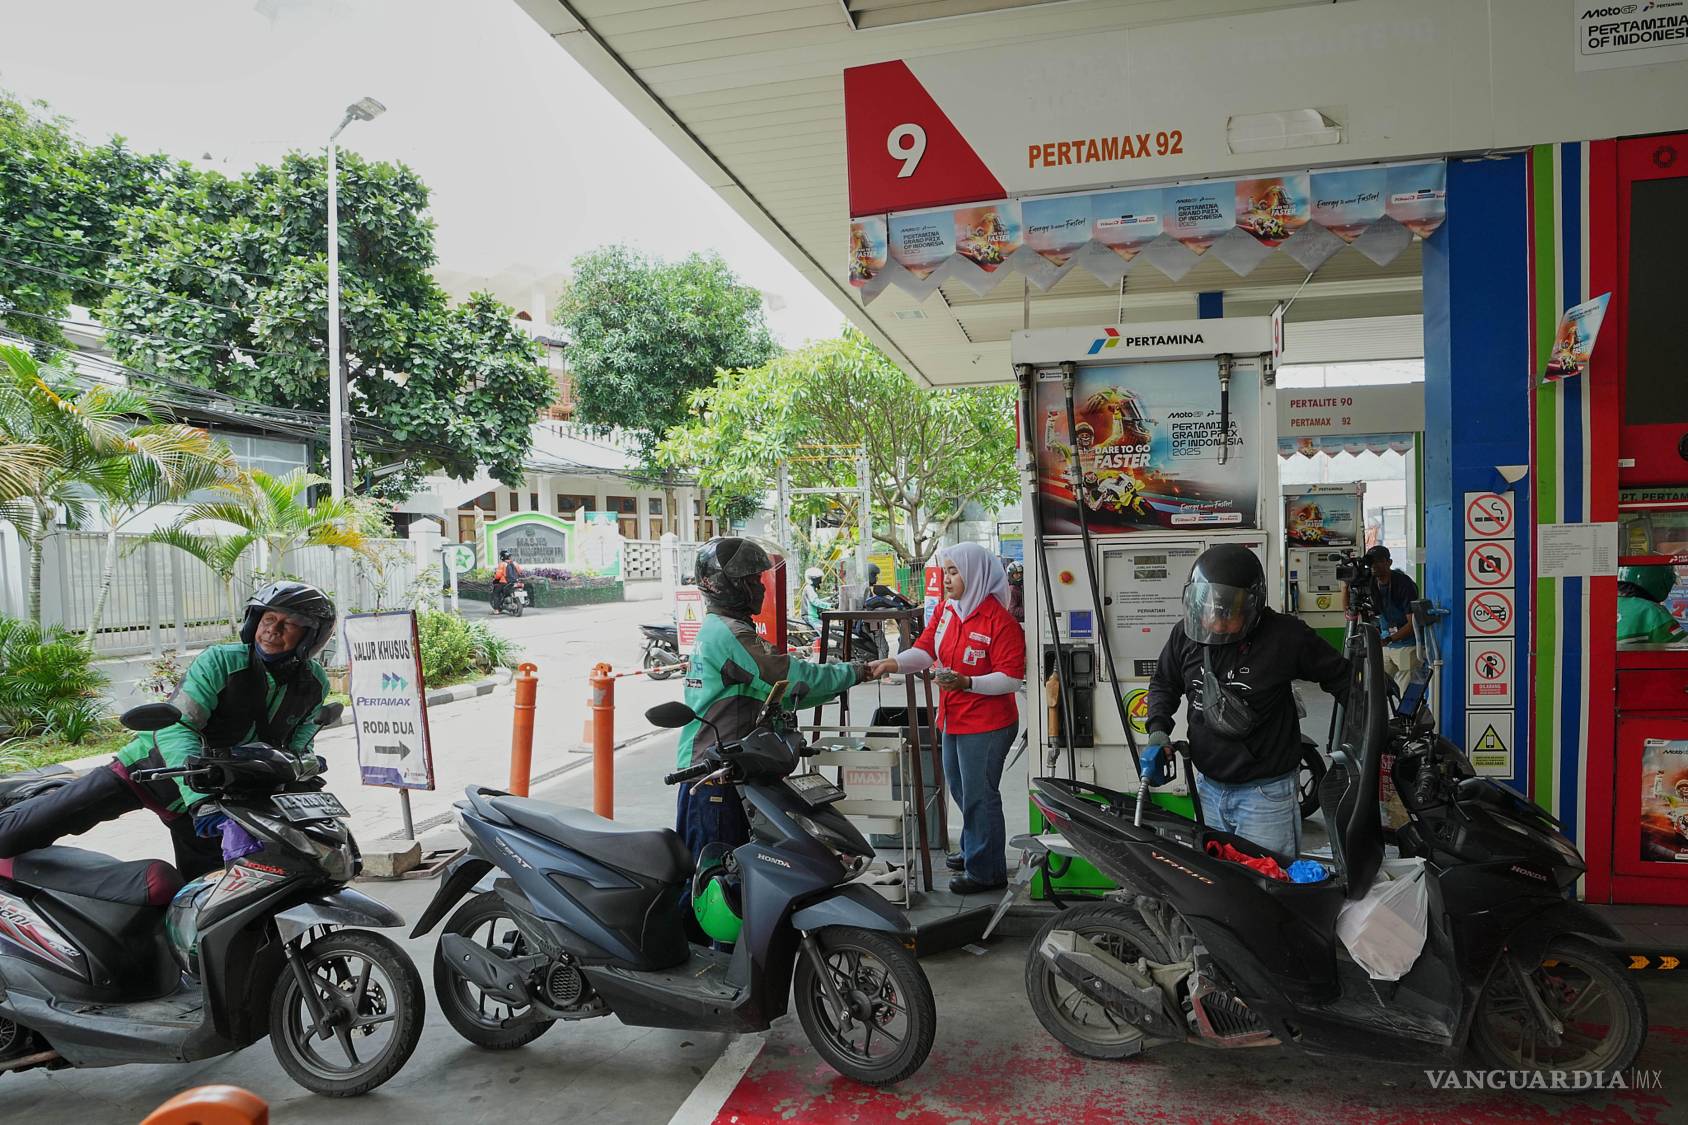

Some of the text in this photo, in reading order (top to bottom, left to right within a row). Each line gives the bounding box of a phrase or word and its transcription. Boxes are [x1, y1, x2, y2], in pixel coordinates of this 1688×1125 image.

[1581, 5, 1638, 19] MotoGP
[1588, 15, 1688, 37] PERTAMINA
[1588, 37, 1610, 48] OF
[887, 123, 927, 178] 9
[1028, 130, 1183, 168] PERTAMAX 92
[1126, 334, 1204, 347] PERTAMINA
[1290, 397, 1353, 408] PERTALITE 90
[1172, 421, 1237, 430] PERTAMIA
[1290, 417, 1352, 427] PERTAMAX 92
[1172, 431, 1208, 439] GRAND
[1188, 437, 1244, 447] INDONSIA
[1095, 444, 1150, 454] DARE TO GO
[1172, 447, 1201, 456] 2025
[1093, 453, 1151, 469] FASTER
[354, 639, 410, 661] JALUR KHUSUS
[356, 696, 411, 706] PERTAMAX
[363, 721, 415, 735] RODA DUA
[757, 853, 791, 868] HONDA
[1511, 865, 1548, 881] HONDA
